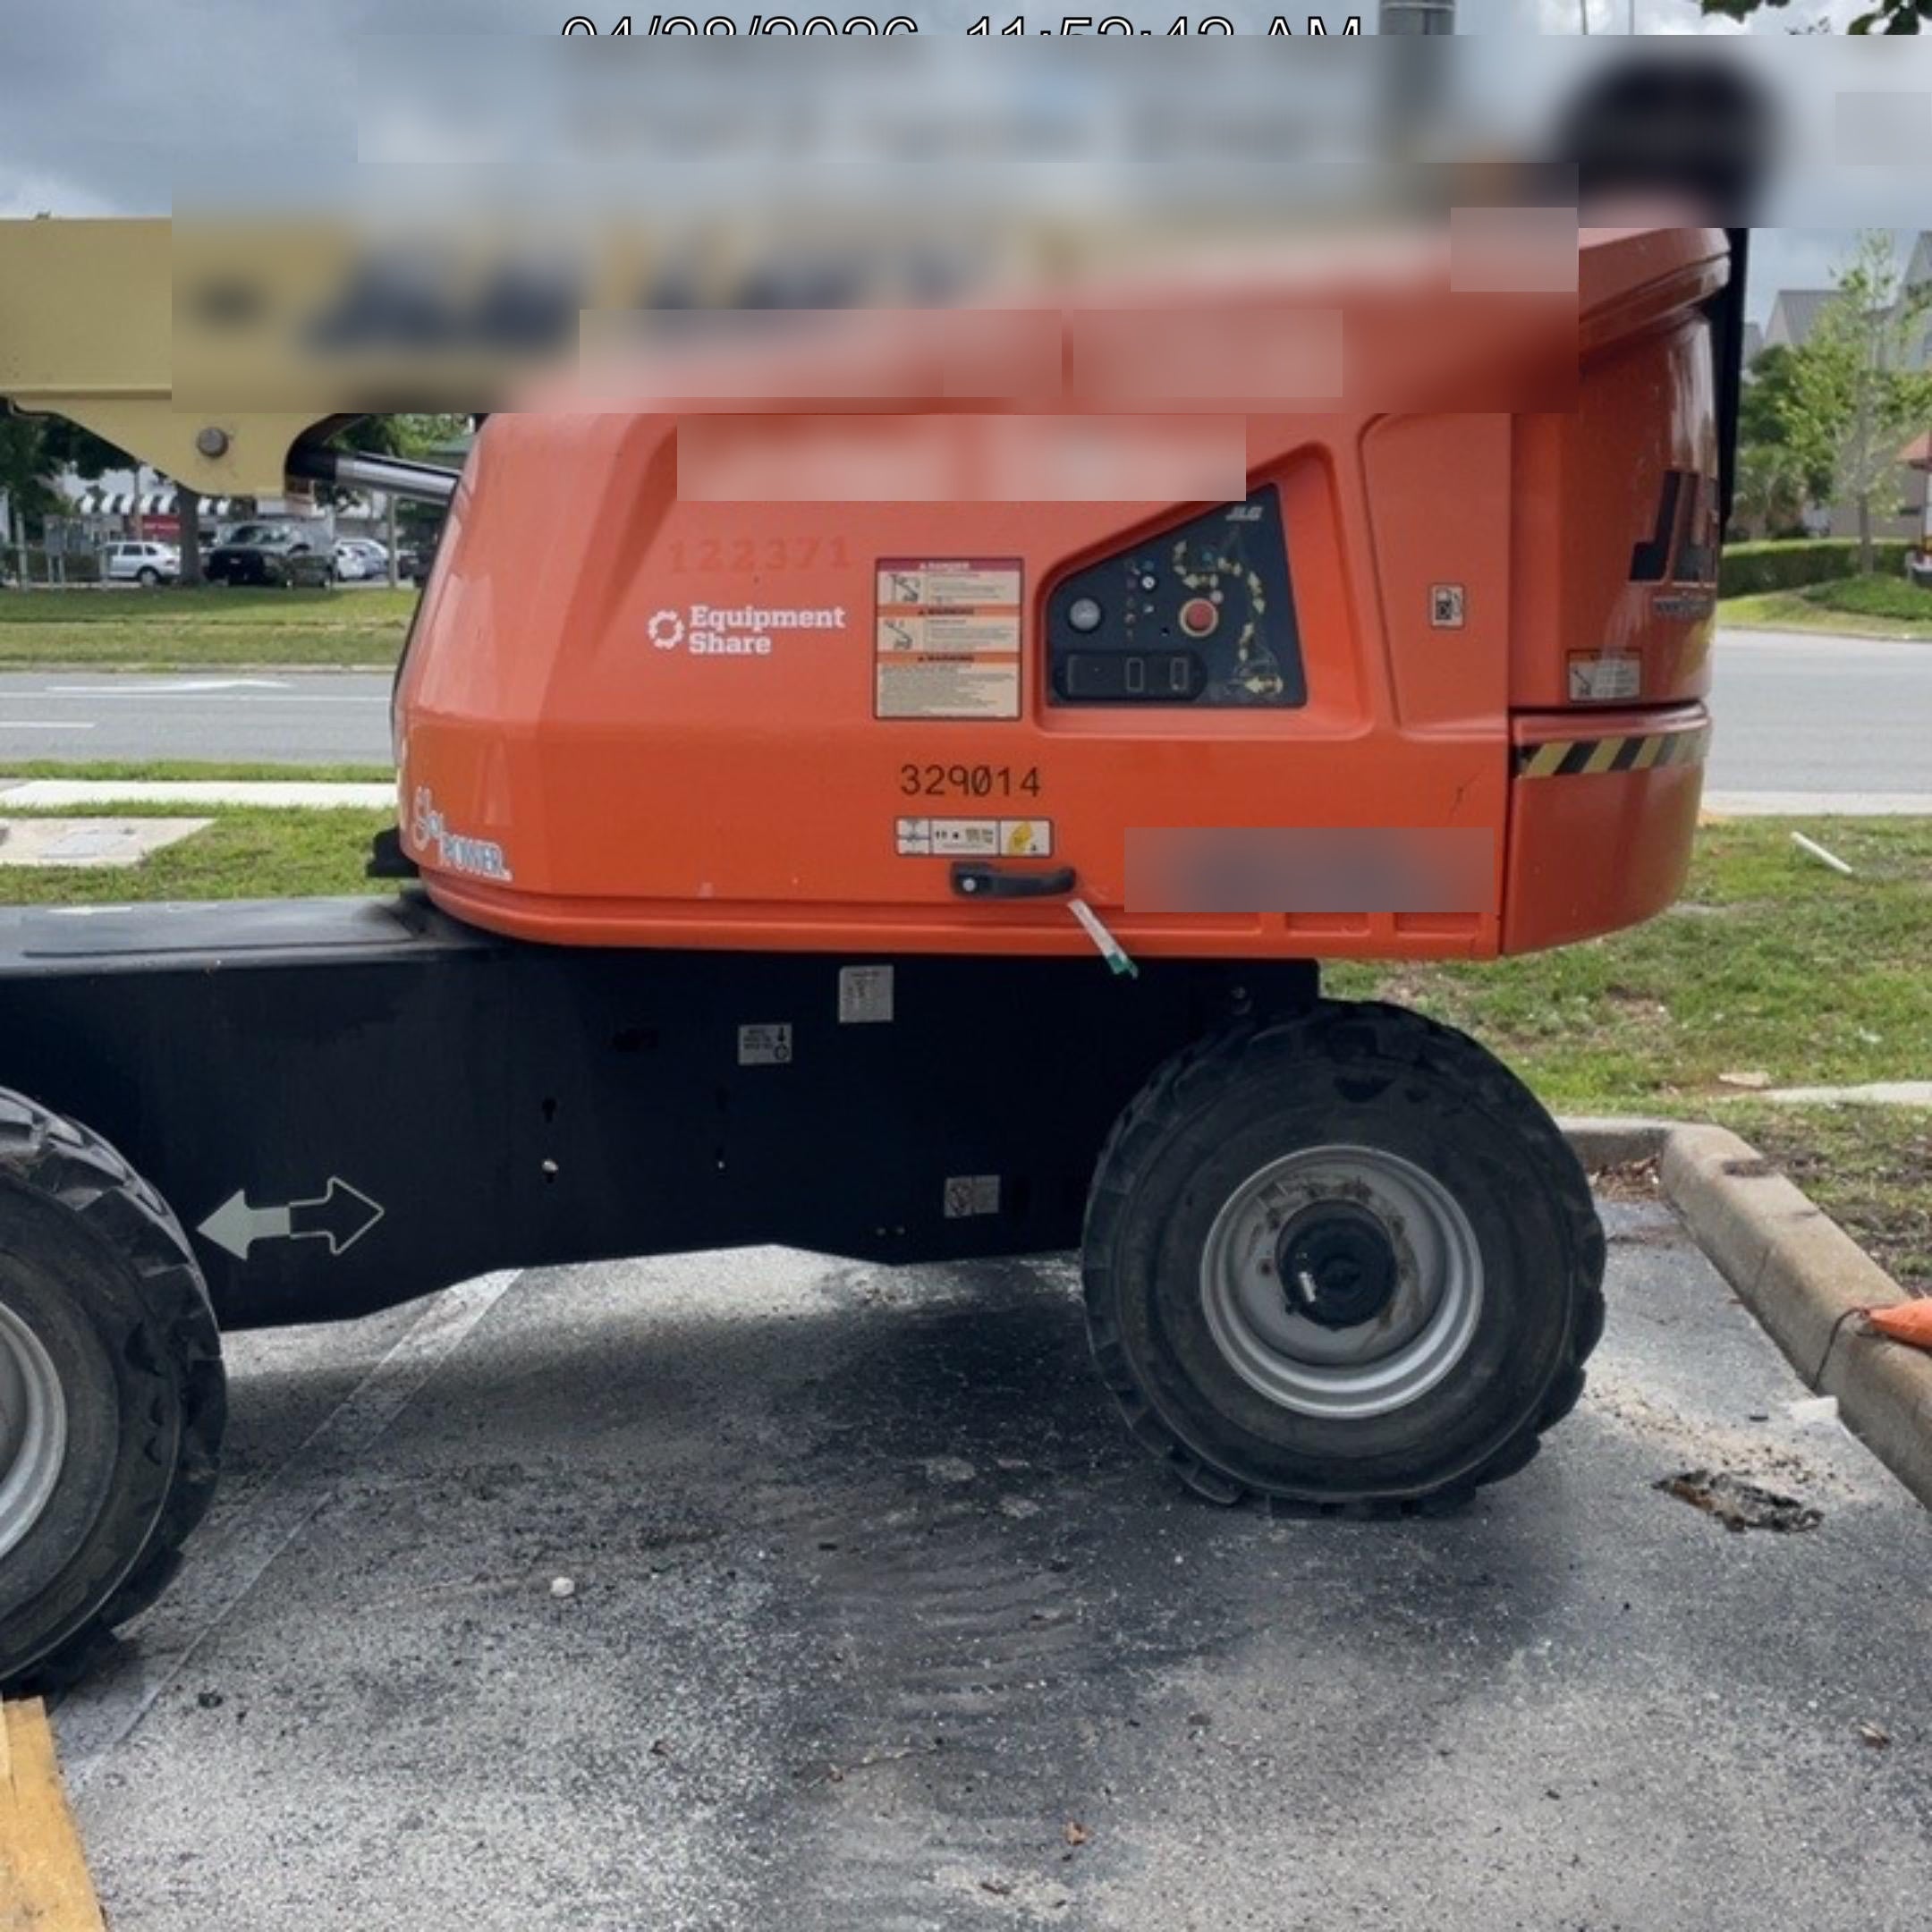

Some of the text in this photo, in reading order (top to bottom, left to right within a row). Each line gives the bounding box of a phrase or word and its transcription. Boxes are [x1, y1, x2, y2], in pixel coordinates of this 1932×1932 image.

[690, 605, 846, 632] Equipment
[689, 631, 772, 655] Share
[901, 764, 1041, 797] 329014
